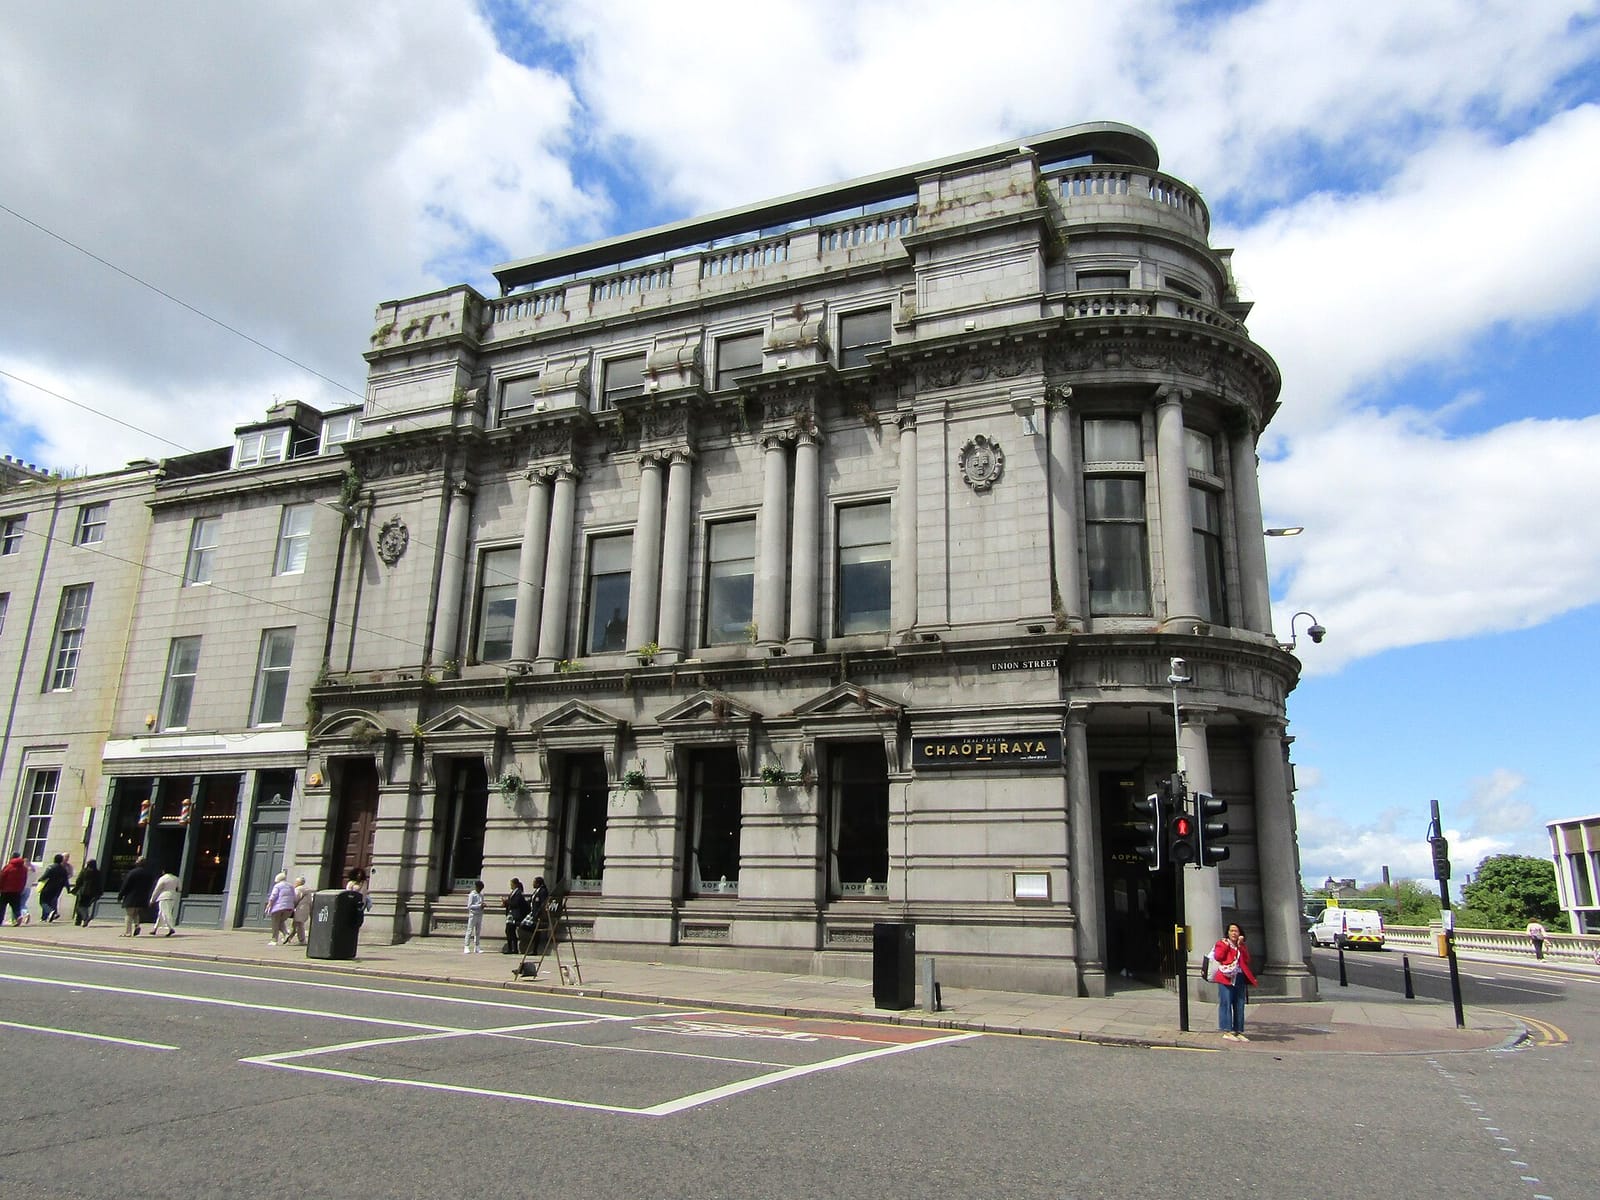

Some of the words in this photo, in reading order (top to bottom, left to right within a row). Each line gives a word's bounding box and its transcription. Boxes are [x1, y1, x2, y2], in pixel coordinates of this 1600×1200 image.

[992, 661, 1019, 670] UNION
[1022, 659, 1058, 669] STREET
[925, 741, 1046, 756] CHAOPHRAYA
